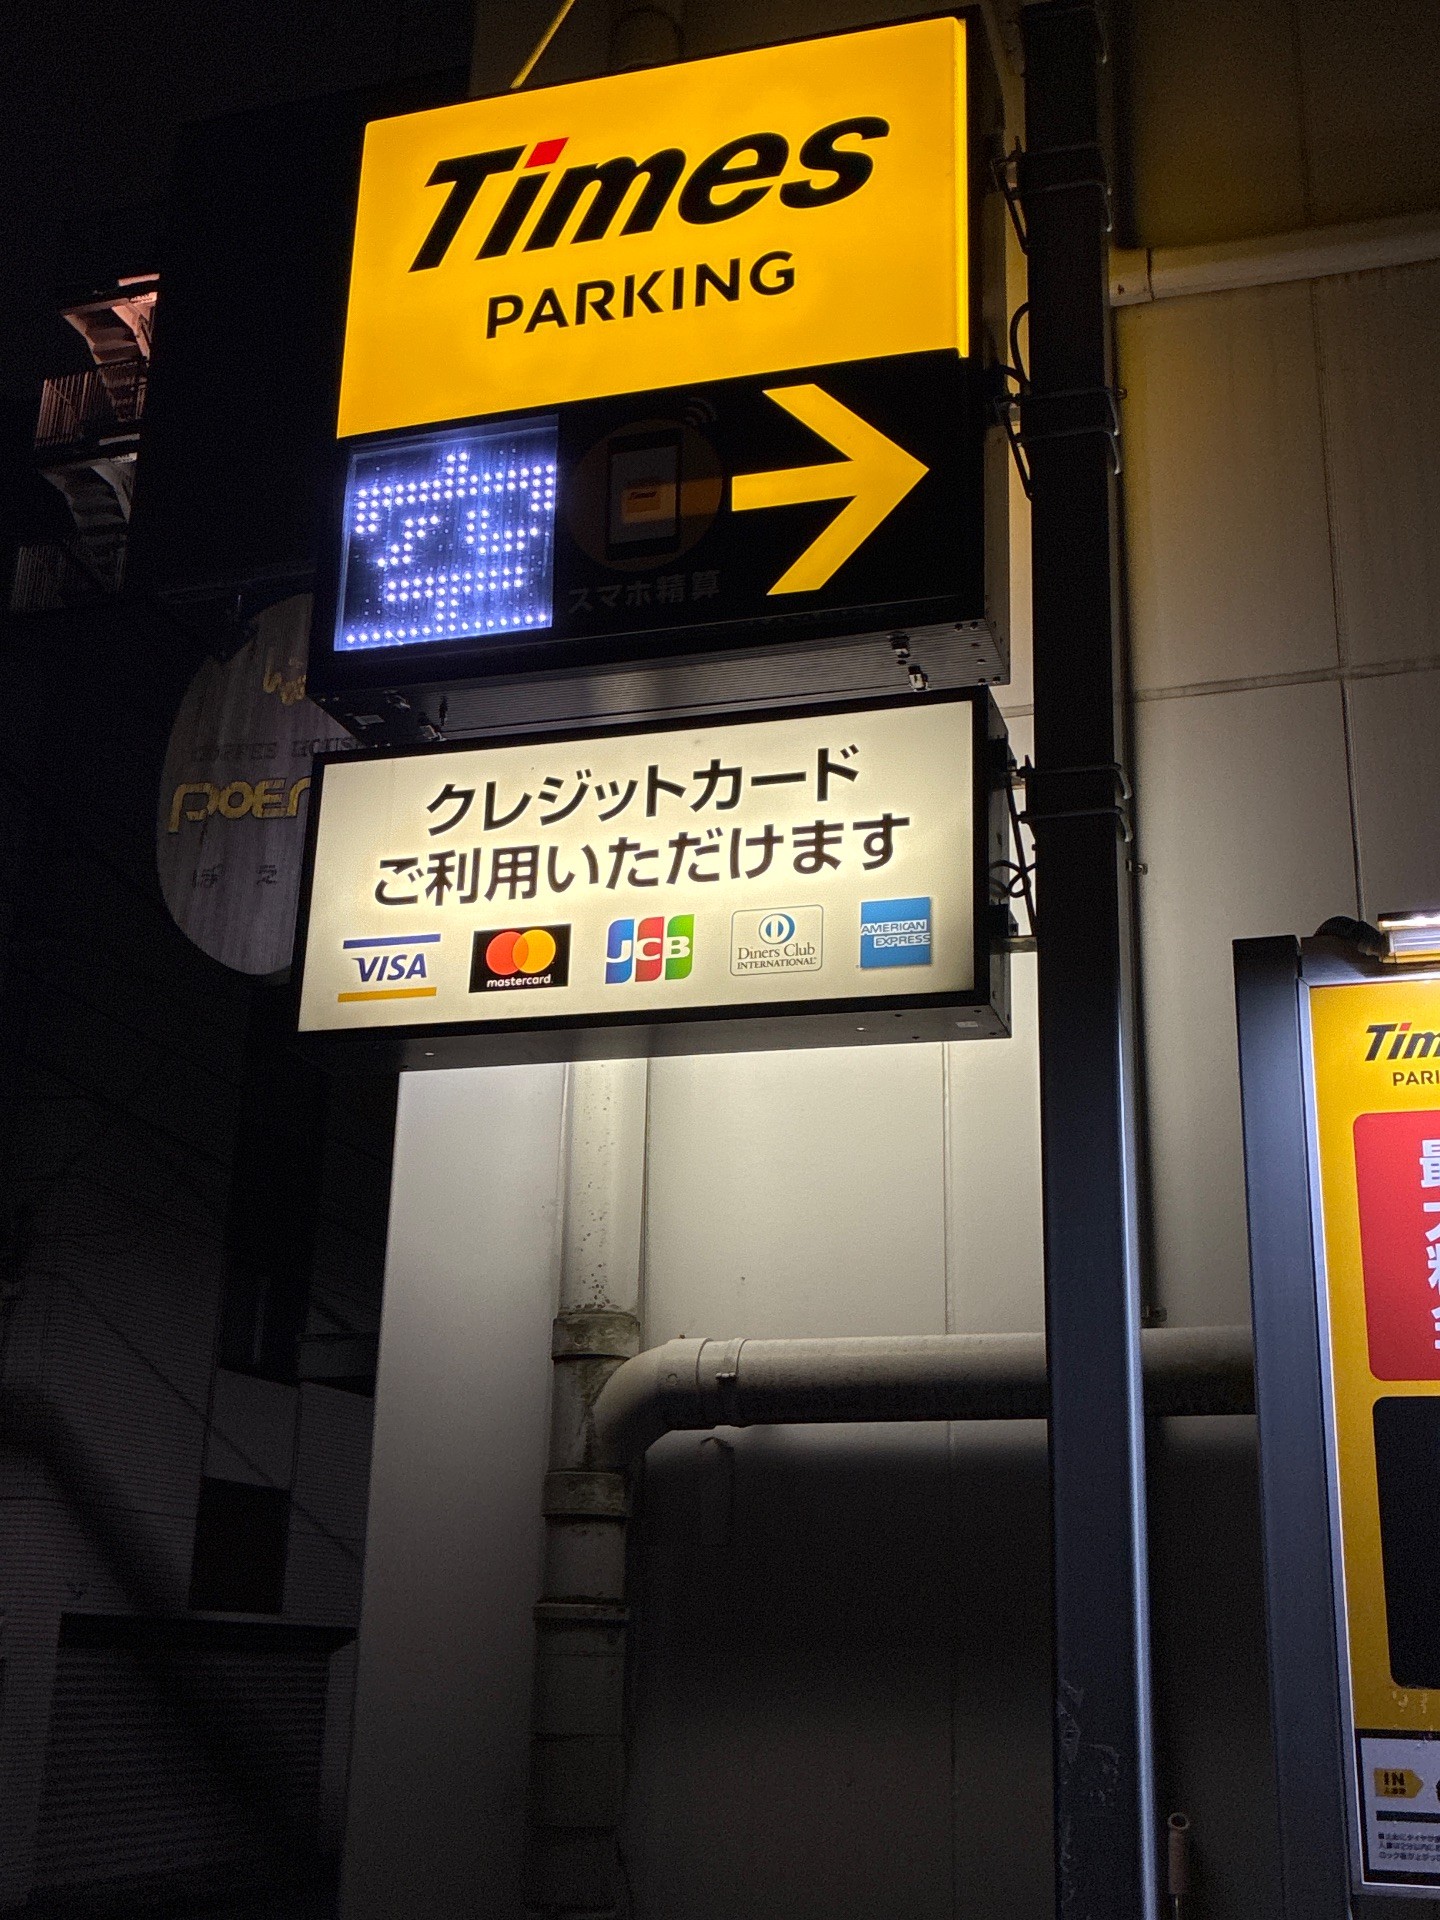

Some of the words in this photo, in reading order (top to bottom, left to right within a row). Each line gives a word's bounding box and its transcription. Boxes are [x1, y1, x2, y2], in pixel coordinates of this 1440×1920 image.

[408, 115, 890, 273] Times
[485, 250, 796, 339] PARKING
[567, 569, 720, 614] スマホ精算
[425, 744, 860, 836] クレジットカード
[373, 812, 911, 907] ご利用いただけます
[861, 921, 926, 934] AMERICAN
[875, 934, 931, 947] EXPRESS
[605, 936, 692, 963] JCB
[737, 948, 780, 960] Diners
[783, 942, 816, 956] Club
[352, 953, 428, 982] VISA
[737, 957, 817, 970] INTERNATIONAL
[486, 973, 552, 988] mastercard
[1383, 1772, 1405, 1786] IN
